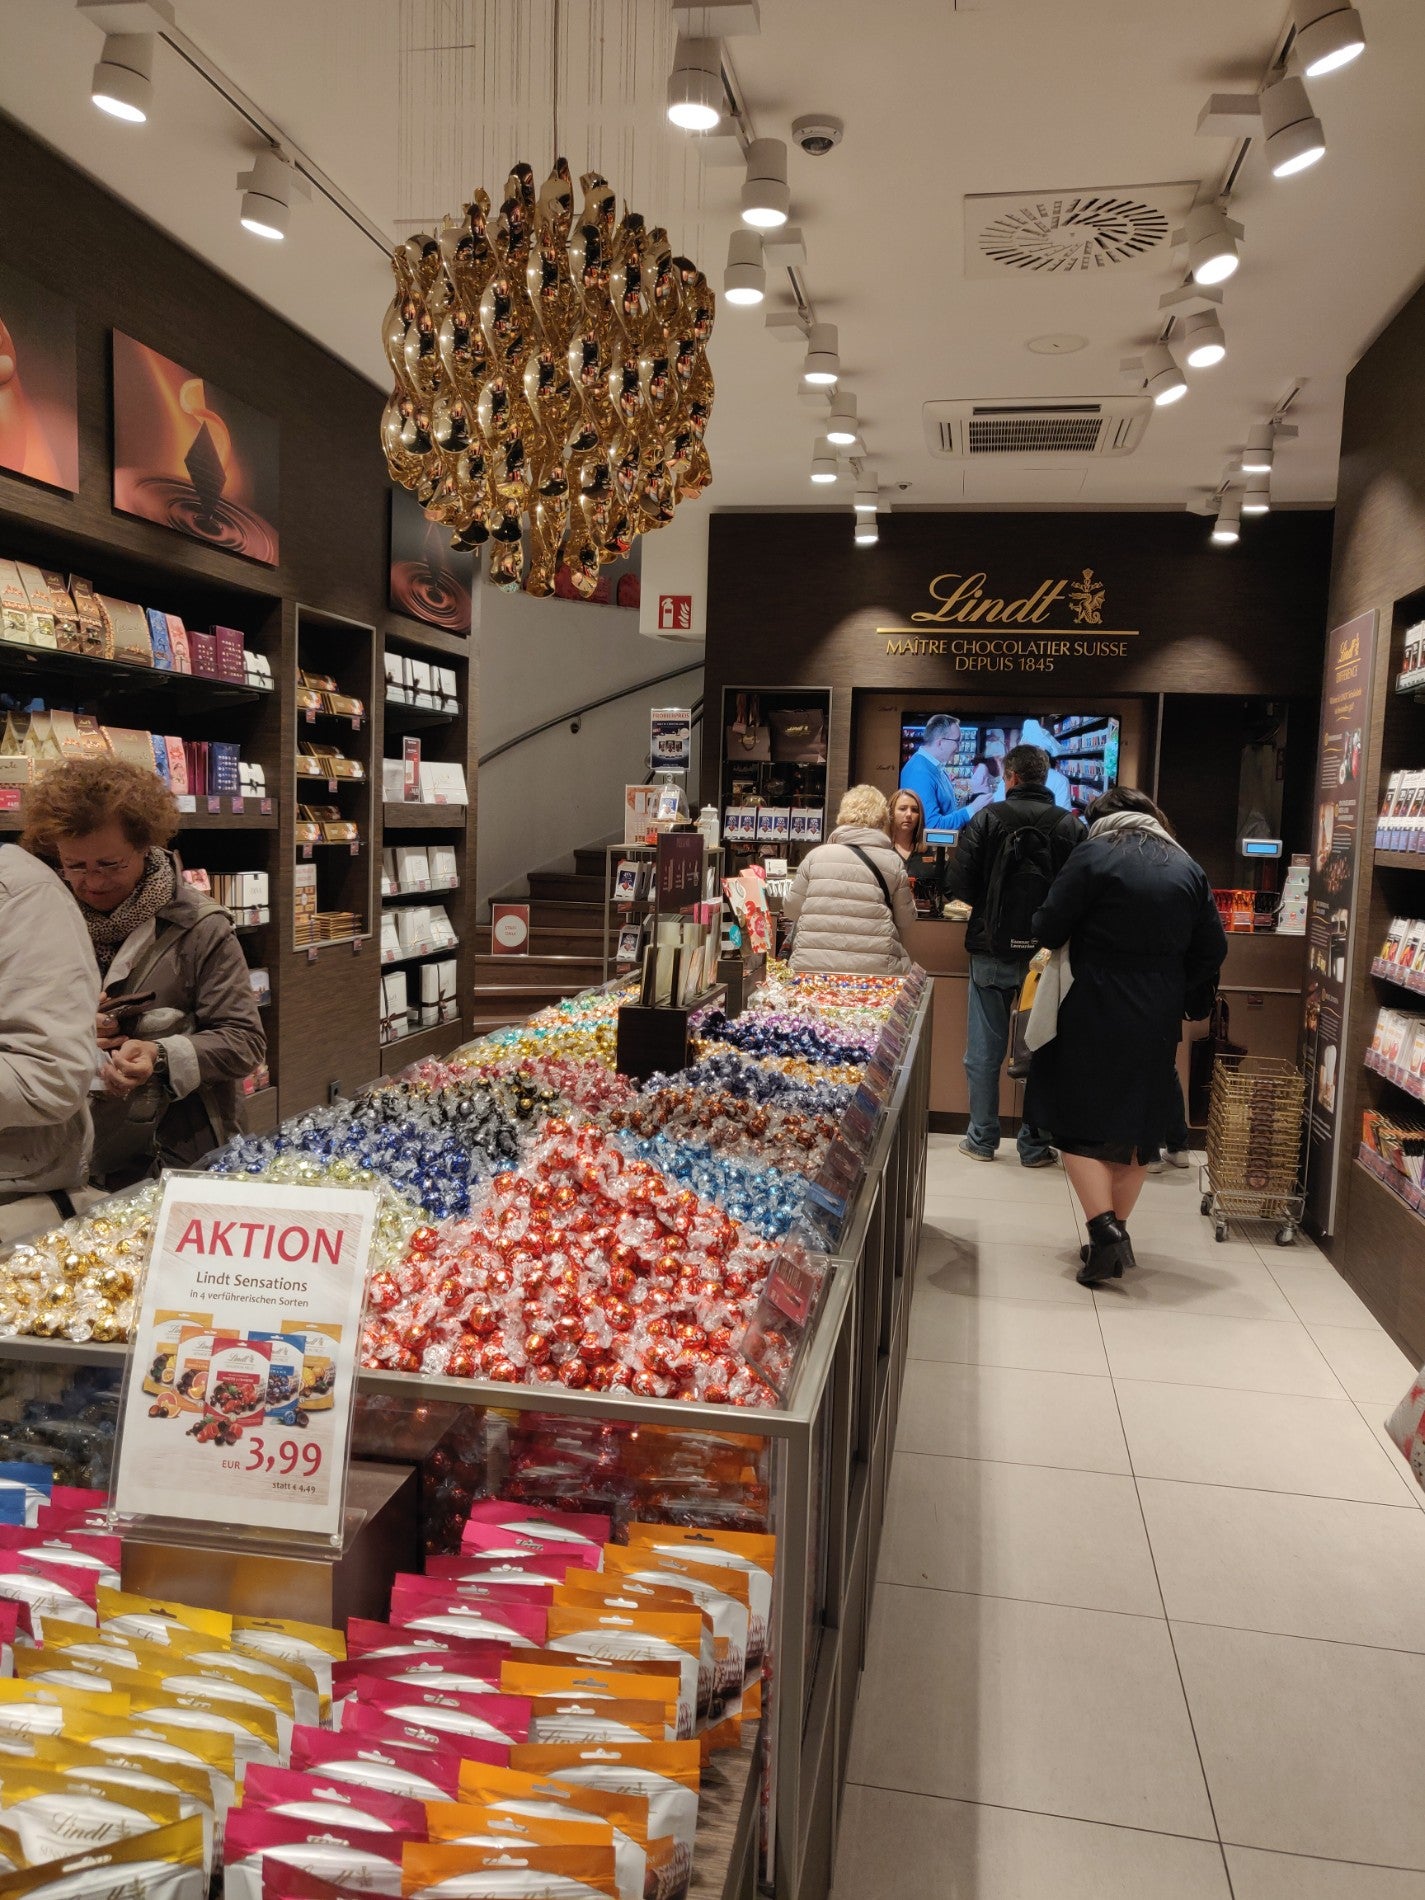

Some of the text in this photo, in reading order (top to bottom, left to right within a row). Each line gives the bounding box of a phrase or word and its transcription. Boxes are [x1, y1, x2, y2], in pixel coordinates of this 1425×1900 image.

[911, 572, 1069, 624] Lindt
[886, 636, 1129, 657] MAÎTRE CHOCOLATIER SUISSE
[955, 656, 1054, 672] DEPUIS 1845
[175, 1219, 344, 1265] AKTION
[196, 1271, 308, 1292] Lindt Sensations
[190, 1289, 198, 1299] in
[207, 1292, 277, 1305] verführerischen
[279, 1296, 309, 1308] Sorten
[222, 1436, 323, 1477] EUR 3,99
[272, 1481, 291, 1490] statt
[52, 1811, 114, 1841] Lindt
